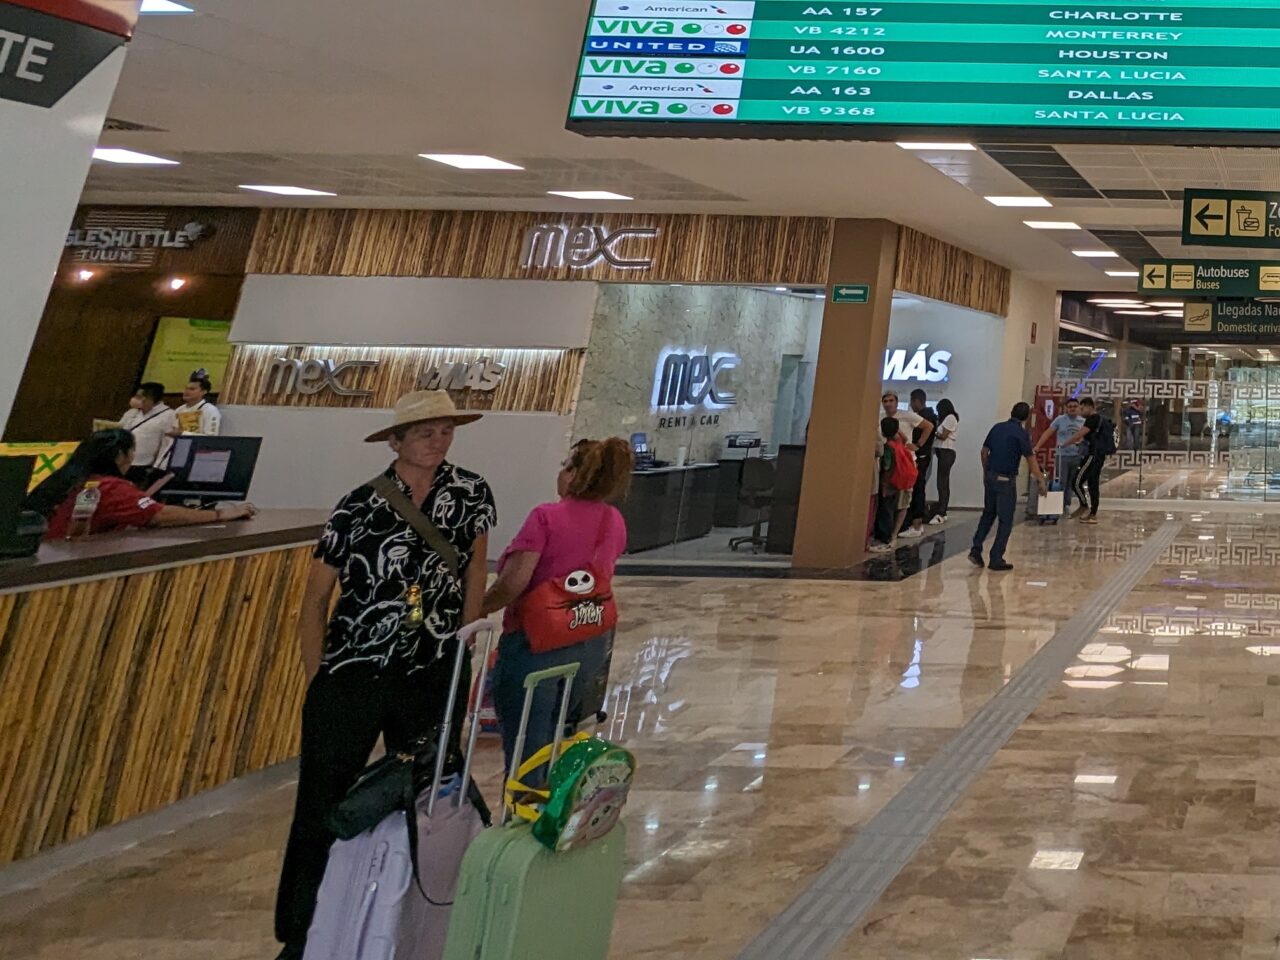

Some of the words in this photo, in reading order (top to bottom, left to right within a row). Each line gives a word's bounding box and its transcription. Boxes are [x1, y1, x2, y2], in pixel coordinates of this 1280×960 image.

[644, 4, 708, 13] American
[802, 6, 832, 16] AA
[843, 7, 882, 17] 157
[1049, 10, 1183, 22] CHARLOTTE
[794, 25, 822, 35] VB
[830, 26, 885, 36] 4212
[1046, 29, 1182, 41] MONTERREY
[590, 40, 706, 50] UNITED
[790, 45, 820, 55] UA
[831, 45, 884, 56] 1600
[0, 29, 55, 83] TE
[1059, 49, 1168, 60] HOUSTON
[788, 65, 816, 75] VB
[826, 65, 881, 76] 7160
[1038, 69, 1111, 79] SANTA
[1120, 70, 1186, 81] LUCIA
[628, 83, 695, 92] American
[790, 85, 821, 95] AA
[832, 86, 871, 96] 163
[1068, 89, 1153, 101] DALLAS
[782, 105, 810, 115] VB
[819, 106, 875, 116] 9368
[1035, 109, 1108, 120] SANTA
[1118, 111, 1184, 121] LUCIA
[80, 249, 133, 261] TULUM
[1197, 265, 1250, 279] Autobuses
[1195, 279, 1221, 291] Buses
[1217, 303, 1262, 319] Llegadas
[1217, 322, 1257, 333] Domestic
[659, 416, 687, 429] RENT
[700, 415, 720, 428] CAR
